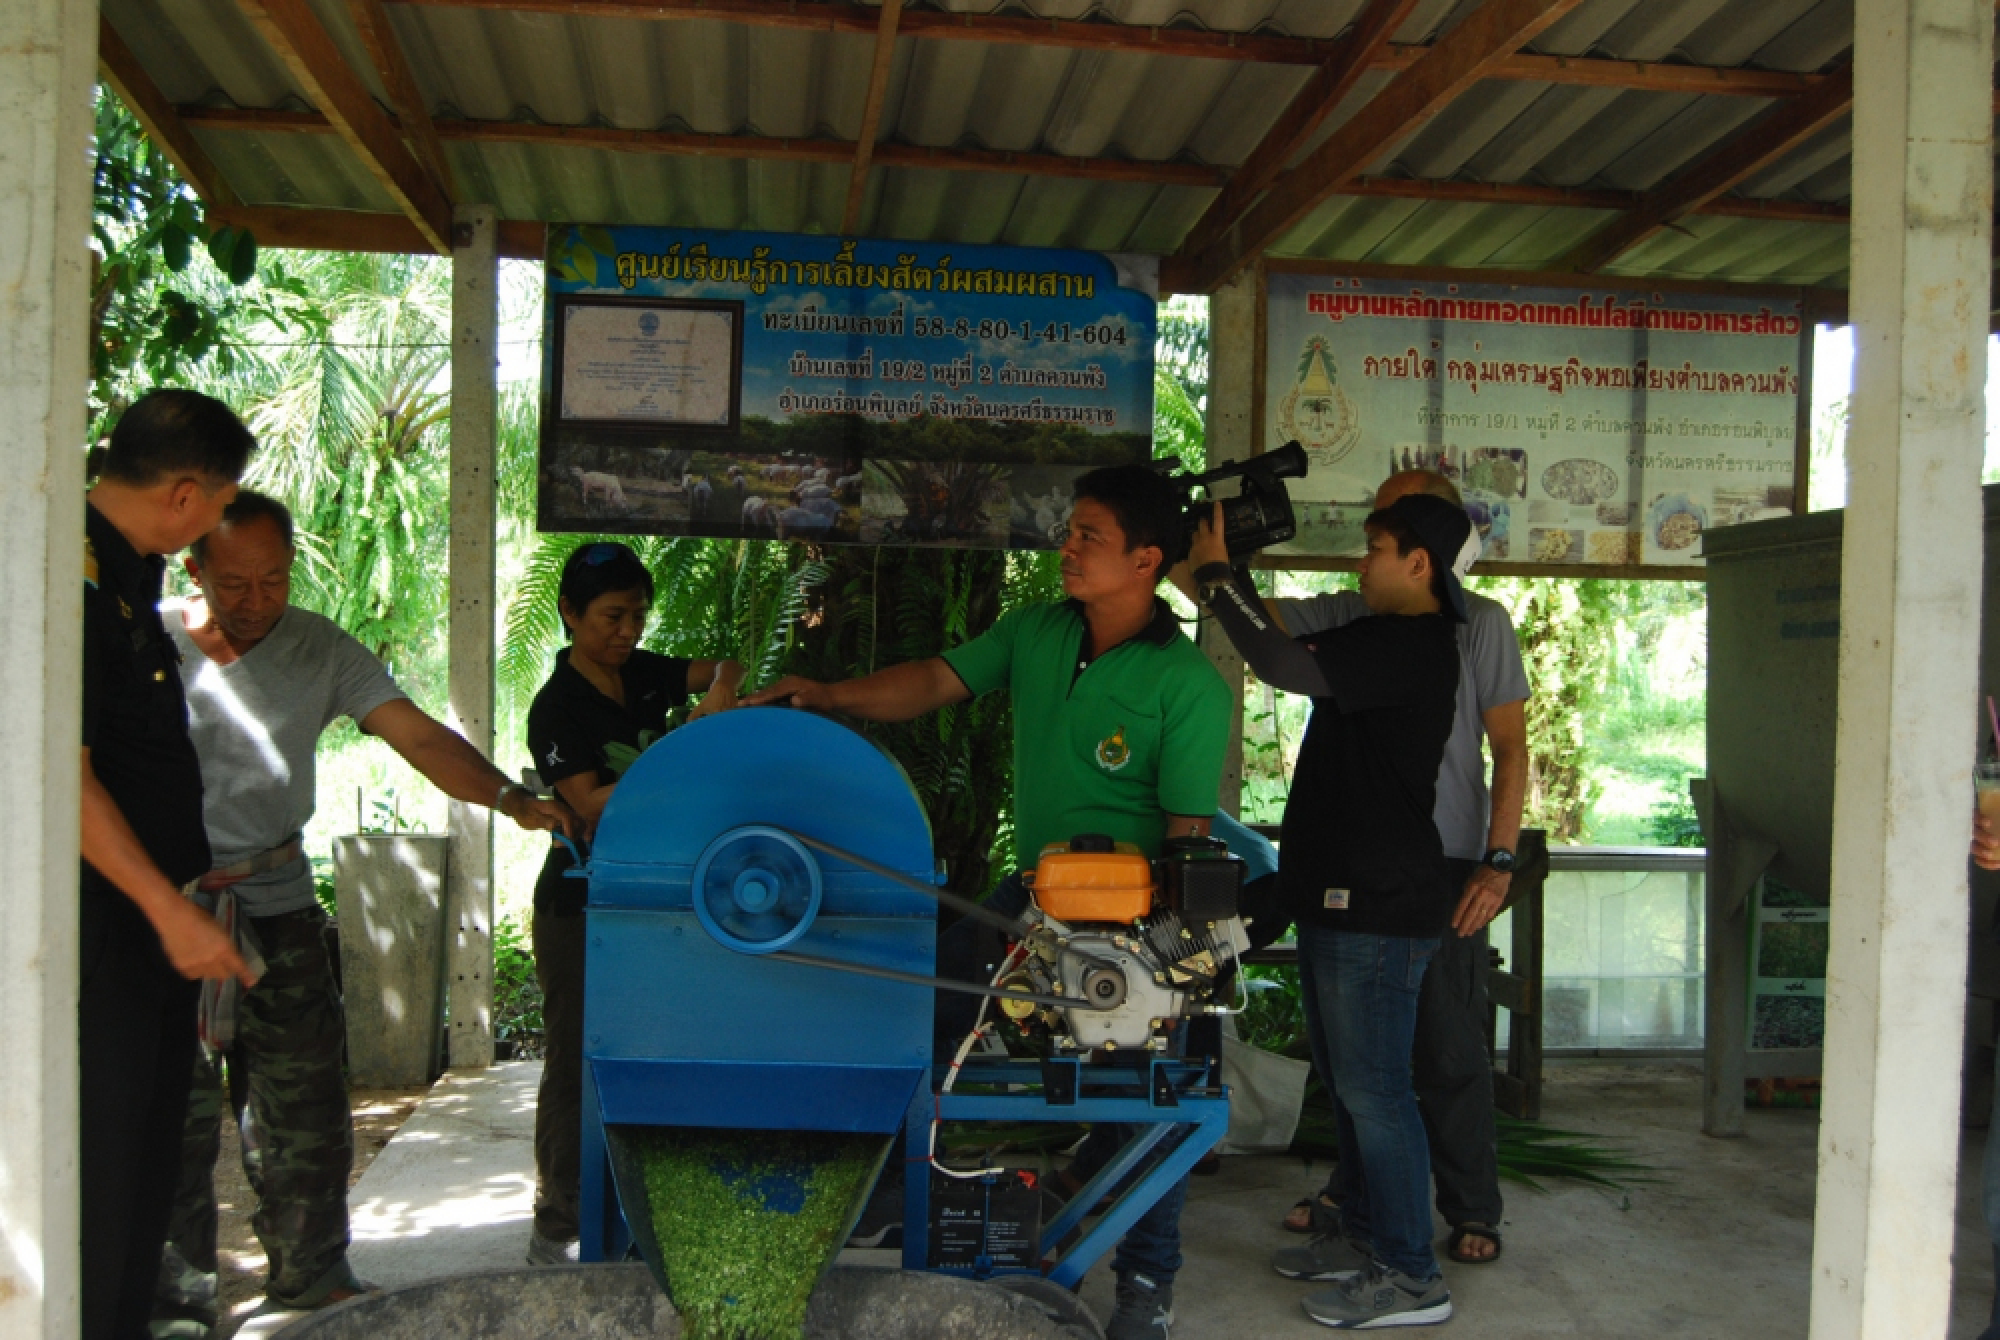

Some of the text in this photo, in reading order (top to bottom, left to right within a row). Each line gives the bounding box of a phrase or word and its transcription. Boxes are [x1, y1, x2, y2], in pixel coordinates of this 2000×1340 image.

[615, 240, 1095, 299] ศูนย์เรียนรู้การเลี้ยงสัตว์ผสมผสาน
[763, 301, 1127, 346] ทะเบียนเลขที่ 58-8-80-1-41-604
[789, 347, 1107, 389] บ้านเลขที่ 19/2 หมู่ที่ 2 ตำบลควนพัง
[1364, 340, 1439, 379] ภายใต้
[779, 386, 1115, 425] อำเภอร่อนพิบูลย์ จังหวัดนครศรีธรรมราช
[1566, 416, 1576, 432] 2
